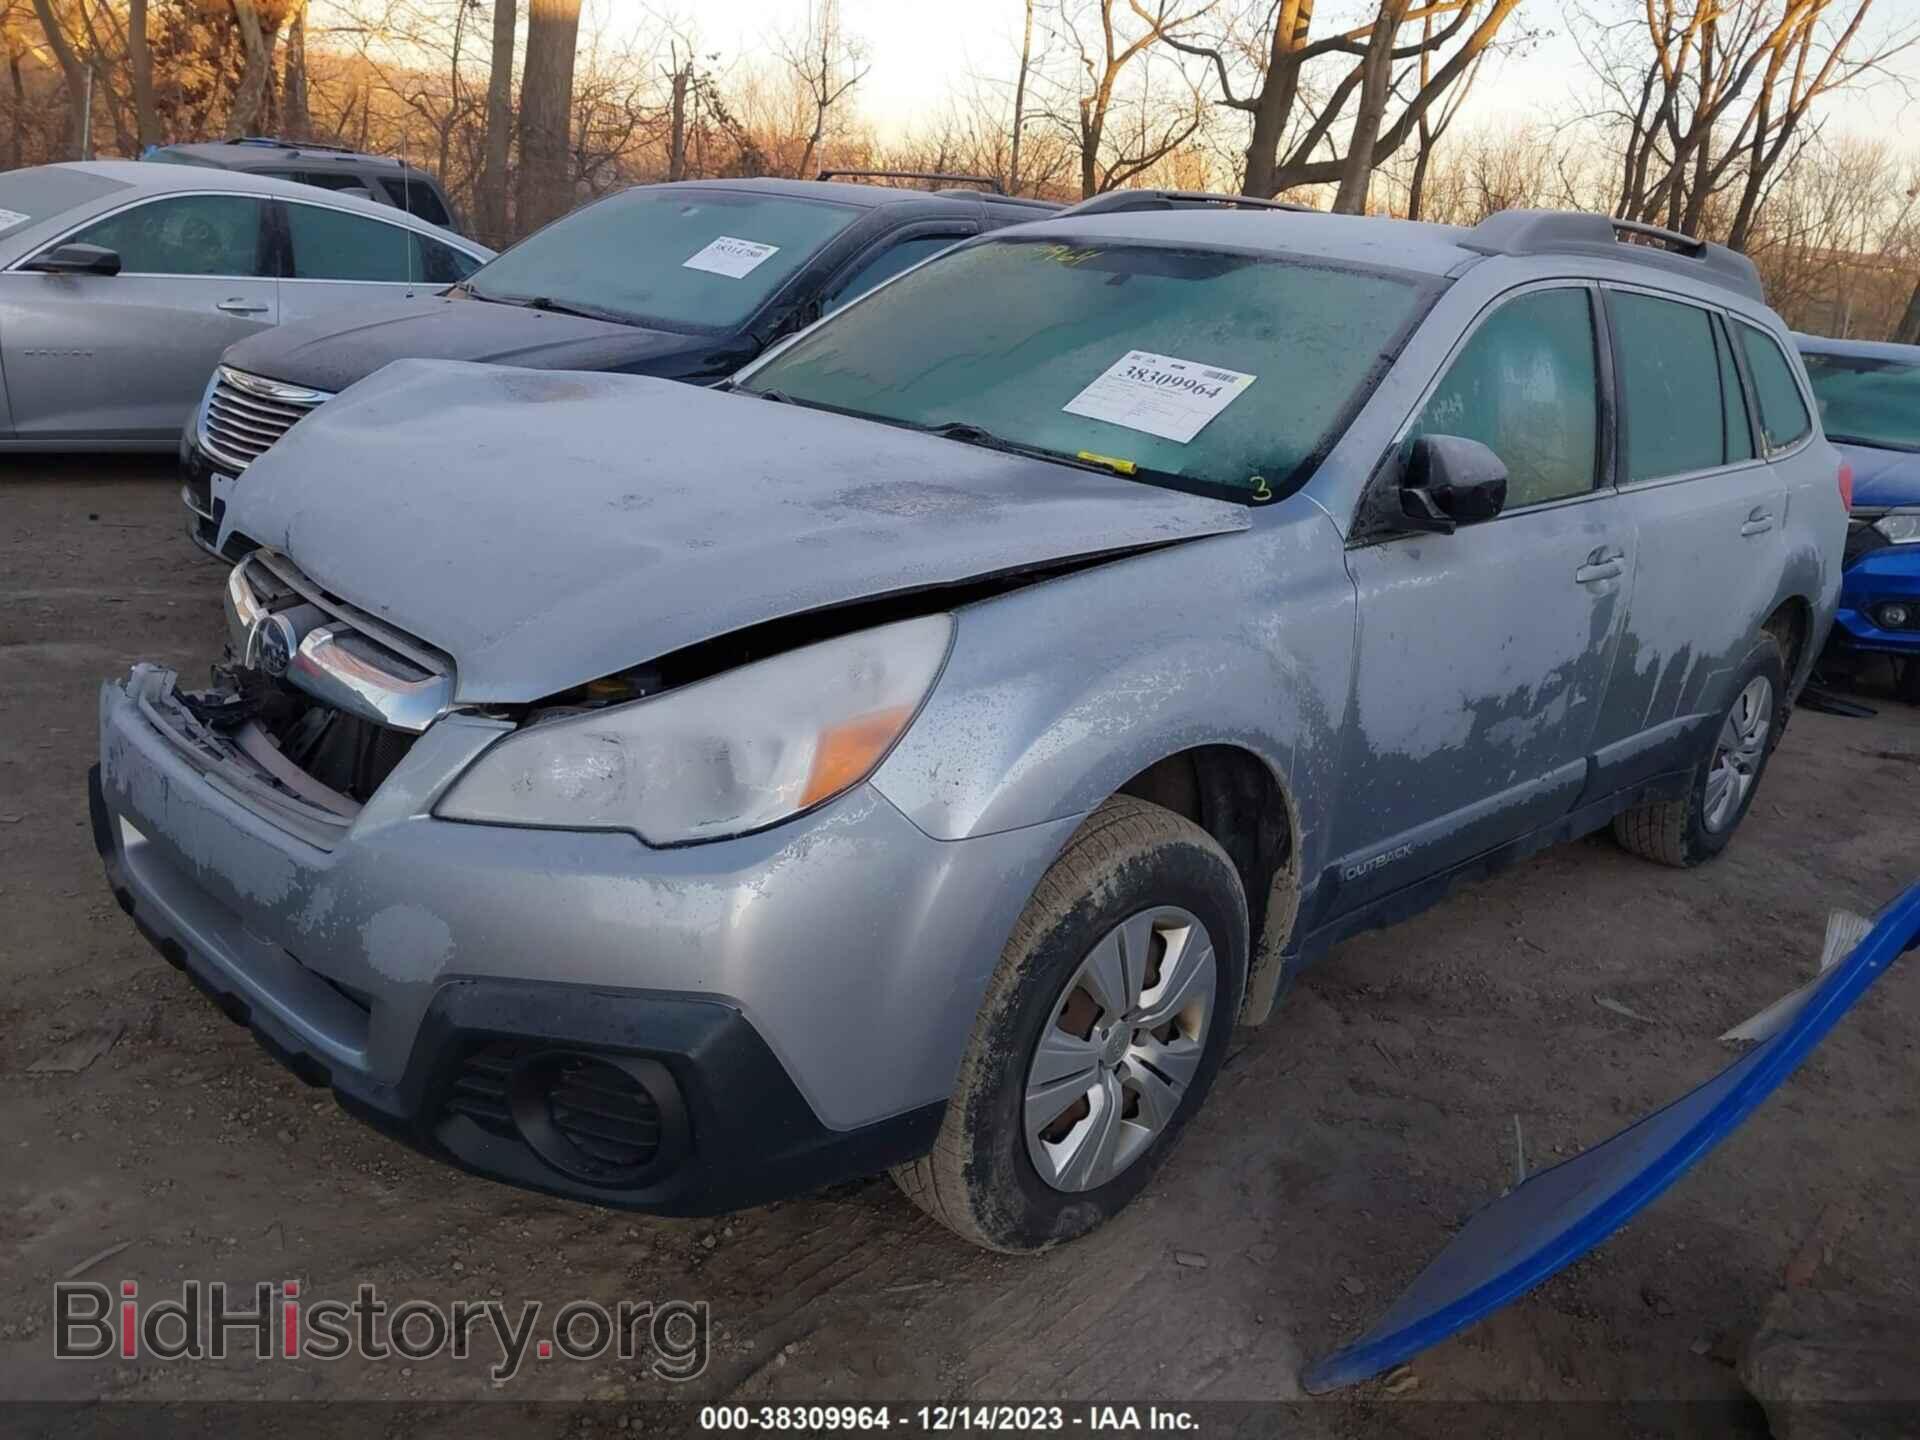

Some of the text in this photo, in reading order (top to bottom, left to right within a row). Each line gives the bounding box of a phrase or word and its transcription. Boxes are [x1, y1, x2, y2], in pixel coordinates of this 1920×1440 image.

[1117, 365, 1222, 398] 38309964
[1249, 476, 1272, 500] 3
[1345, 844, 1414, 880] OUTBACK
